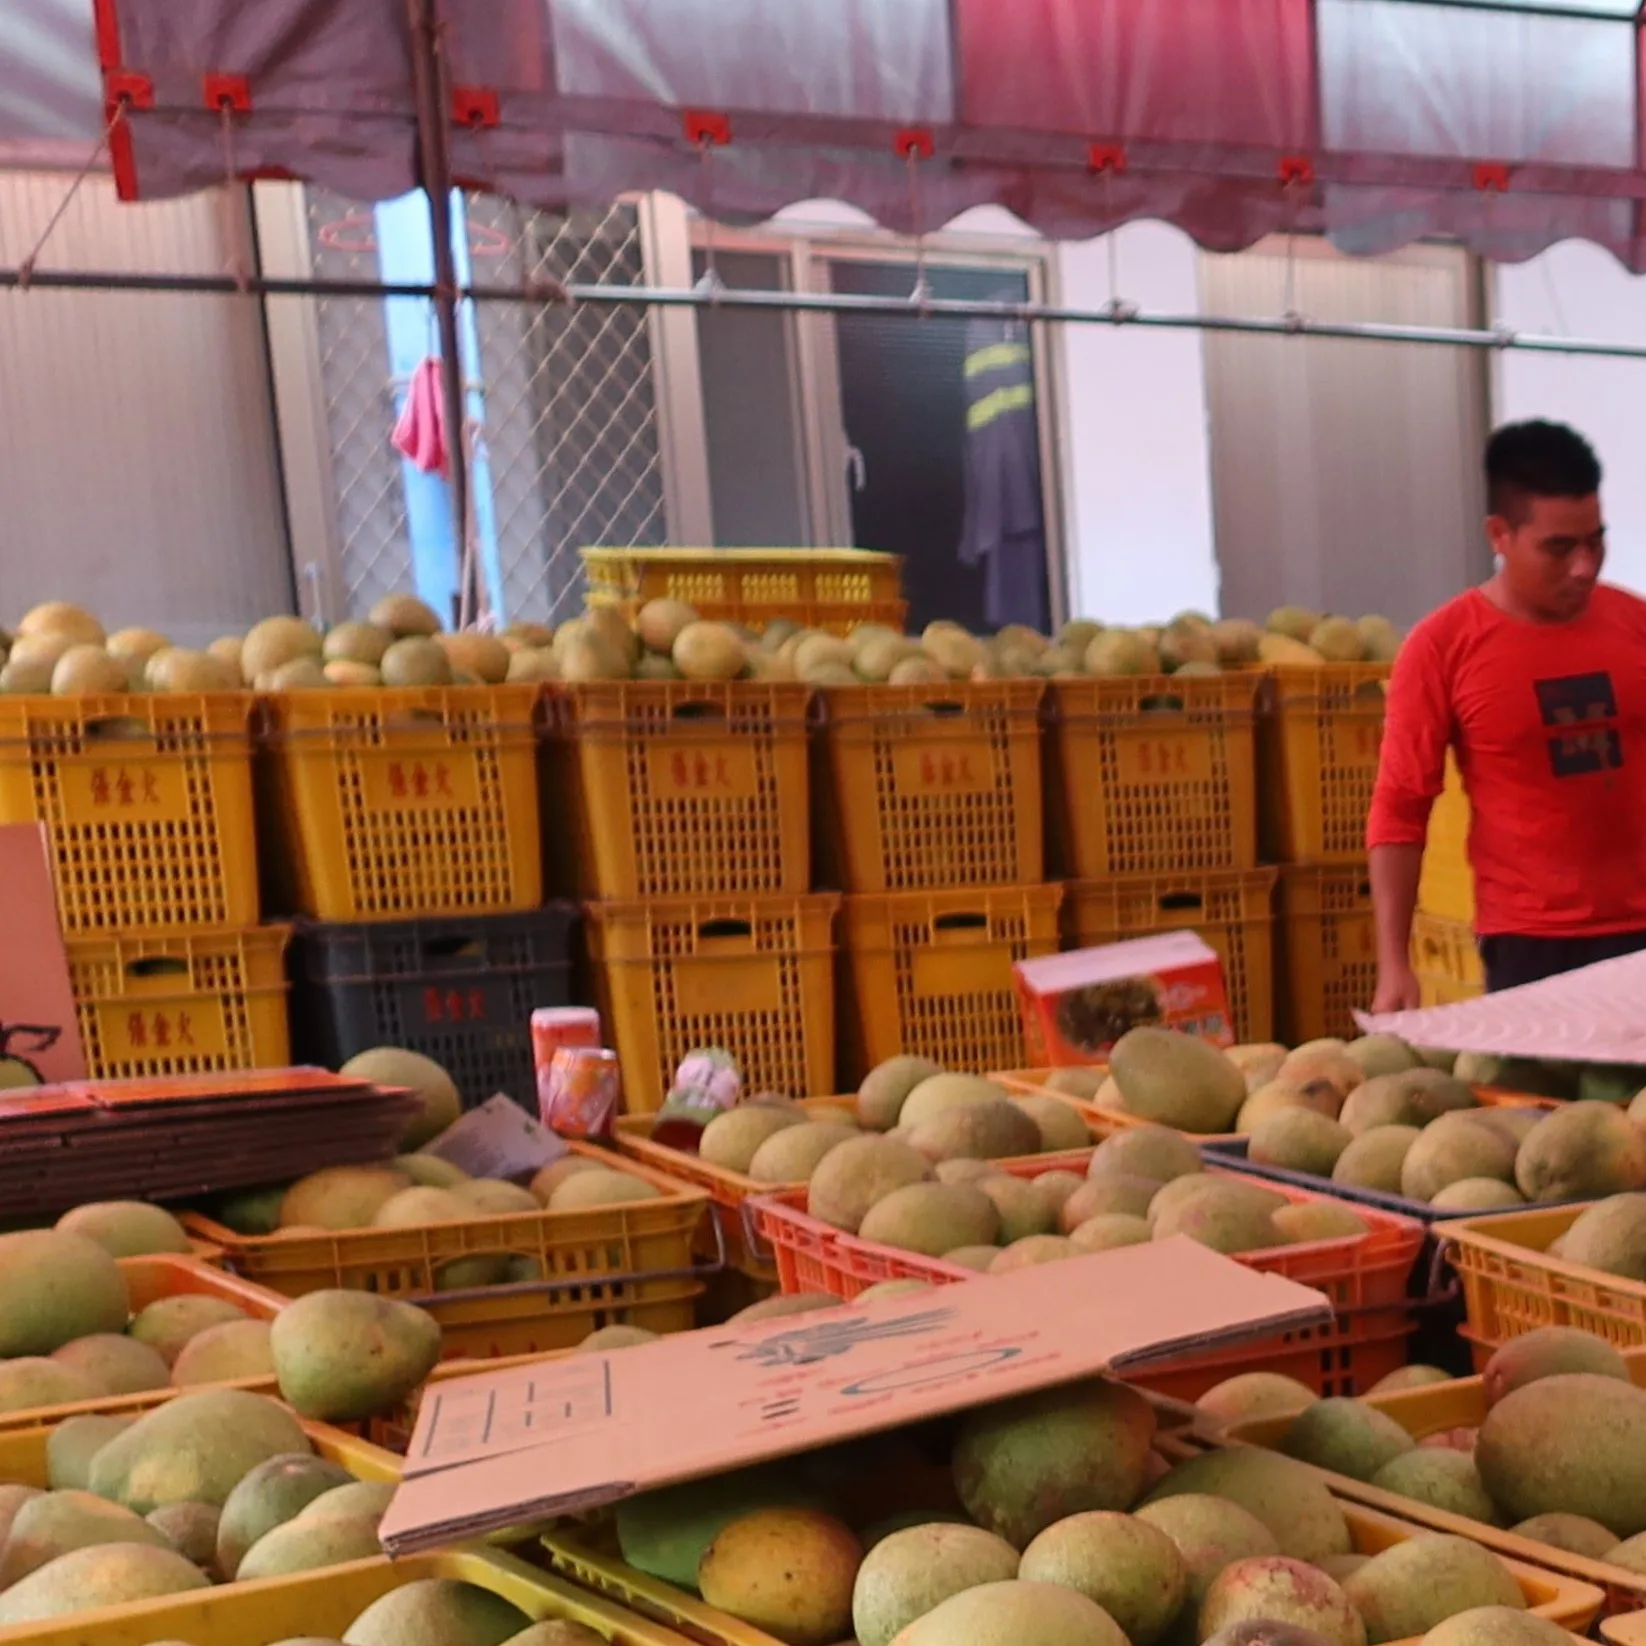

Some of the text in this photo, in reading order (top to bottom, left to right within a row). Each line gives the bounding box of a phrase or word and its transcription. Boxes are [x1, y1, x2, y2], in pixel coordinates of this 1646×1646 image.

[90, 766, 162, 806] 張金火
[126, 1010, 195, 1048] 張金火
